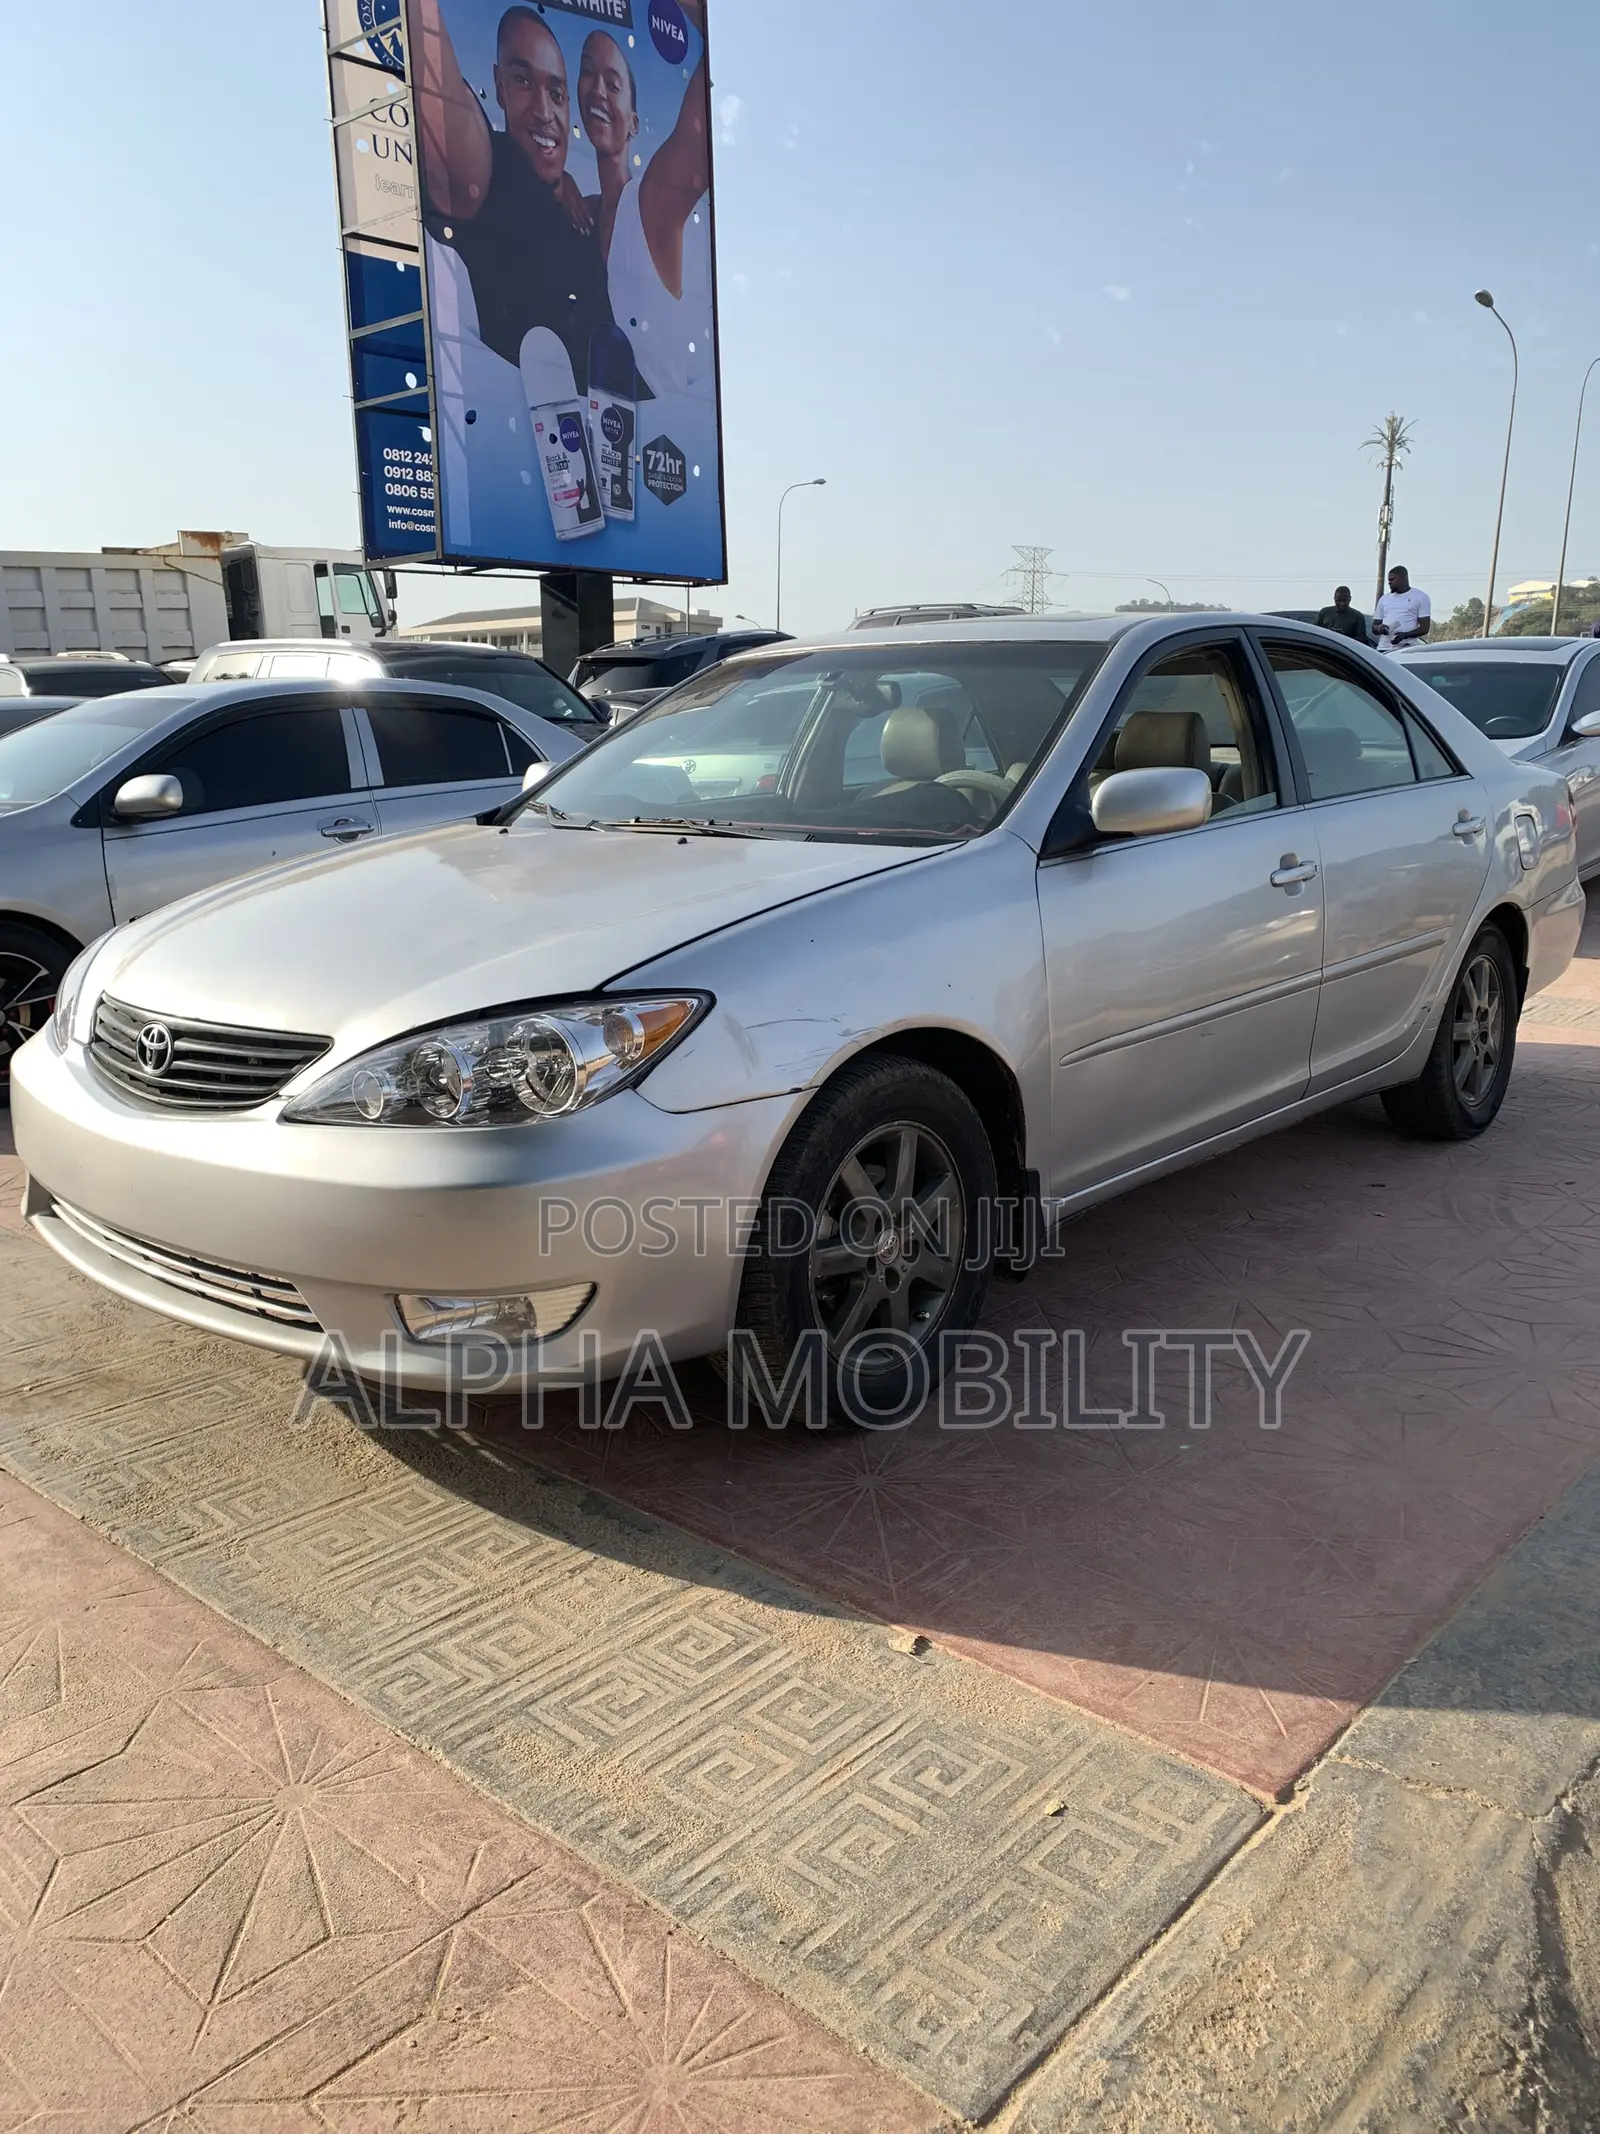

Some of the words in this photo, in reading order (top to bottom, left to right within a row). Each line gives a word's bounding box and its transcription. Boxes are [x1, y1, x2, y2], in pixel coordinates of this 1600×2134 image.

[652, 14, 685, 43] NIVEA
[370, 133, 412, 165] UN
[603, 417, 621, 429] NIVEA
[562, 430, 580, 440] NIVEA
[383, 448, 412, 463] 0812
[646, 449, 682, 475] 72hr
[384, 465, 414, 480] 0912
[416, 470, 434, 483] 88
[385, 483, 418, 498] 0806
[420, 487, 435, 500] 55
[648, 479, 684, 492] PROTECTION
